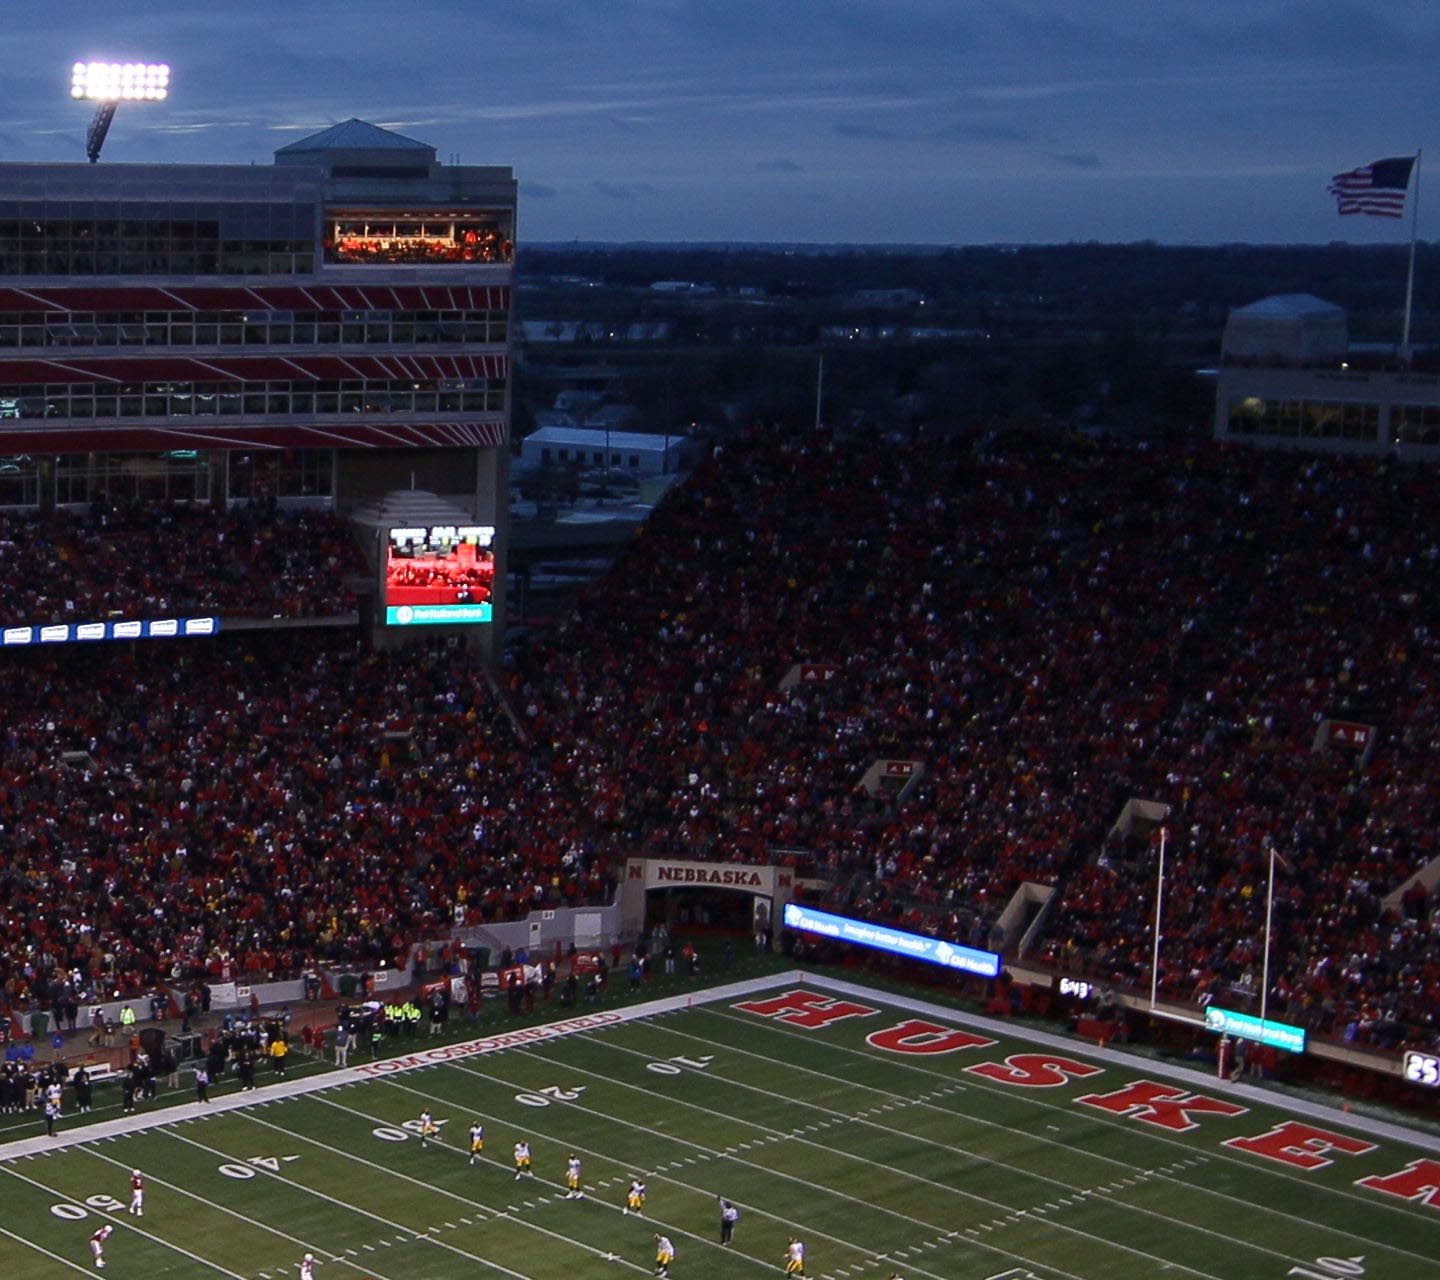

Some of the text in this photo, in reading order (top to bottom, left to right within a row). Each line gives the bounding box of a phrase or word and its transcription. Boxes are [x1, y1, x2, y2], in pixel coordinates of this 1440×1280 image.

[628, 865, 642, 879] N
[657, 866, 762, 886] NEBRASKA
[778, 873, 792, 887] N
[1059, 977, 1089, 999] 6:43
[357, 1011, 622, 1076] TOM OSBORNE FIELD
[646, 1055, 704, 1076] 10
[1407, 1055, 1438, 1084] 25
[514, 1086, 575, 1108] 20
[218, 1155, 284, 1182] 40
[50, 1193, 126, 1222] 50
